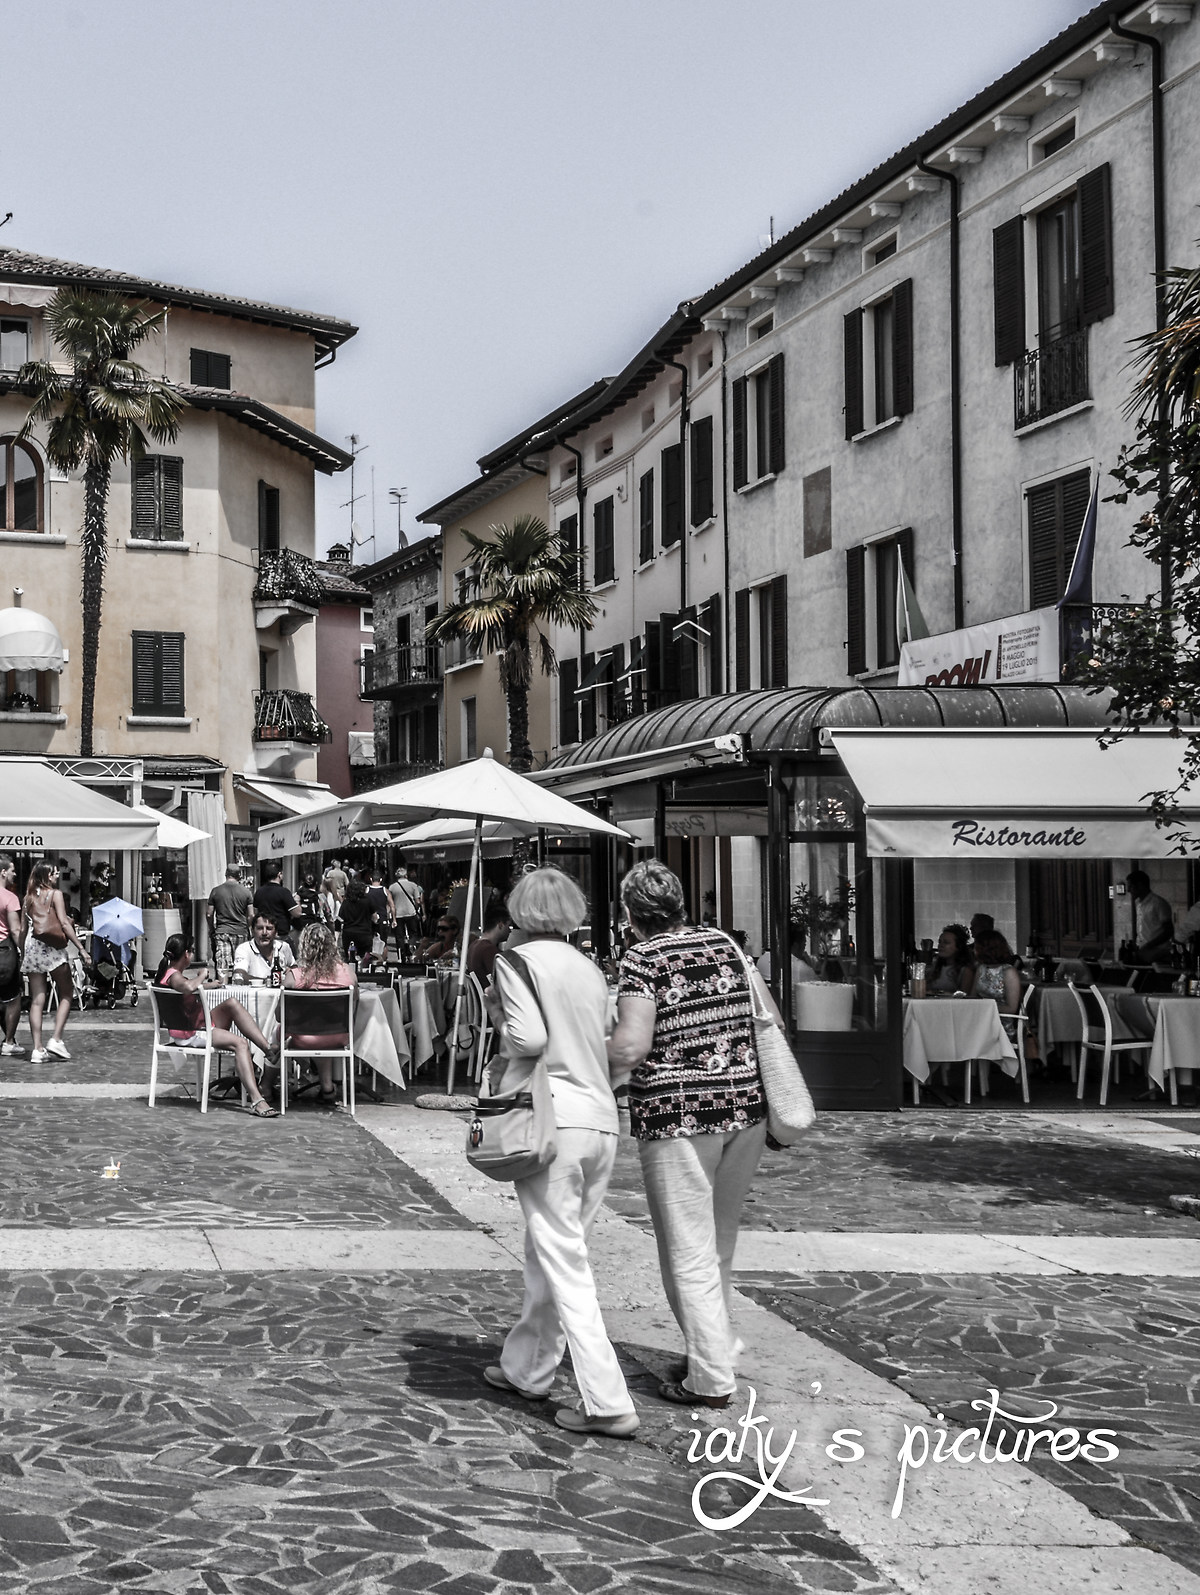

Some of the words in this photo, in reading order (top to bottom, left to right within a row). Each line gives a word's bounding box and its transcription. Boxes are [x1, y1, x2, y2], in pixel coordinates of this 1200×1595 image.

[1006, 651, 1025, 661] MAGGIO
[1009, 659, 1025, 670] LUGLIO
[925, 650, 992, 686] OOM!
[952, 819, 1087, 846] Ristorante
